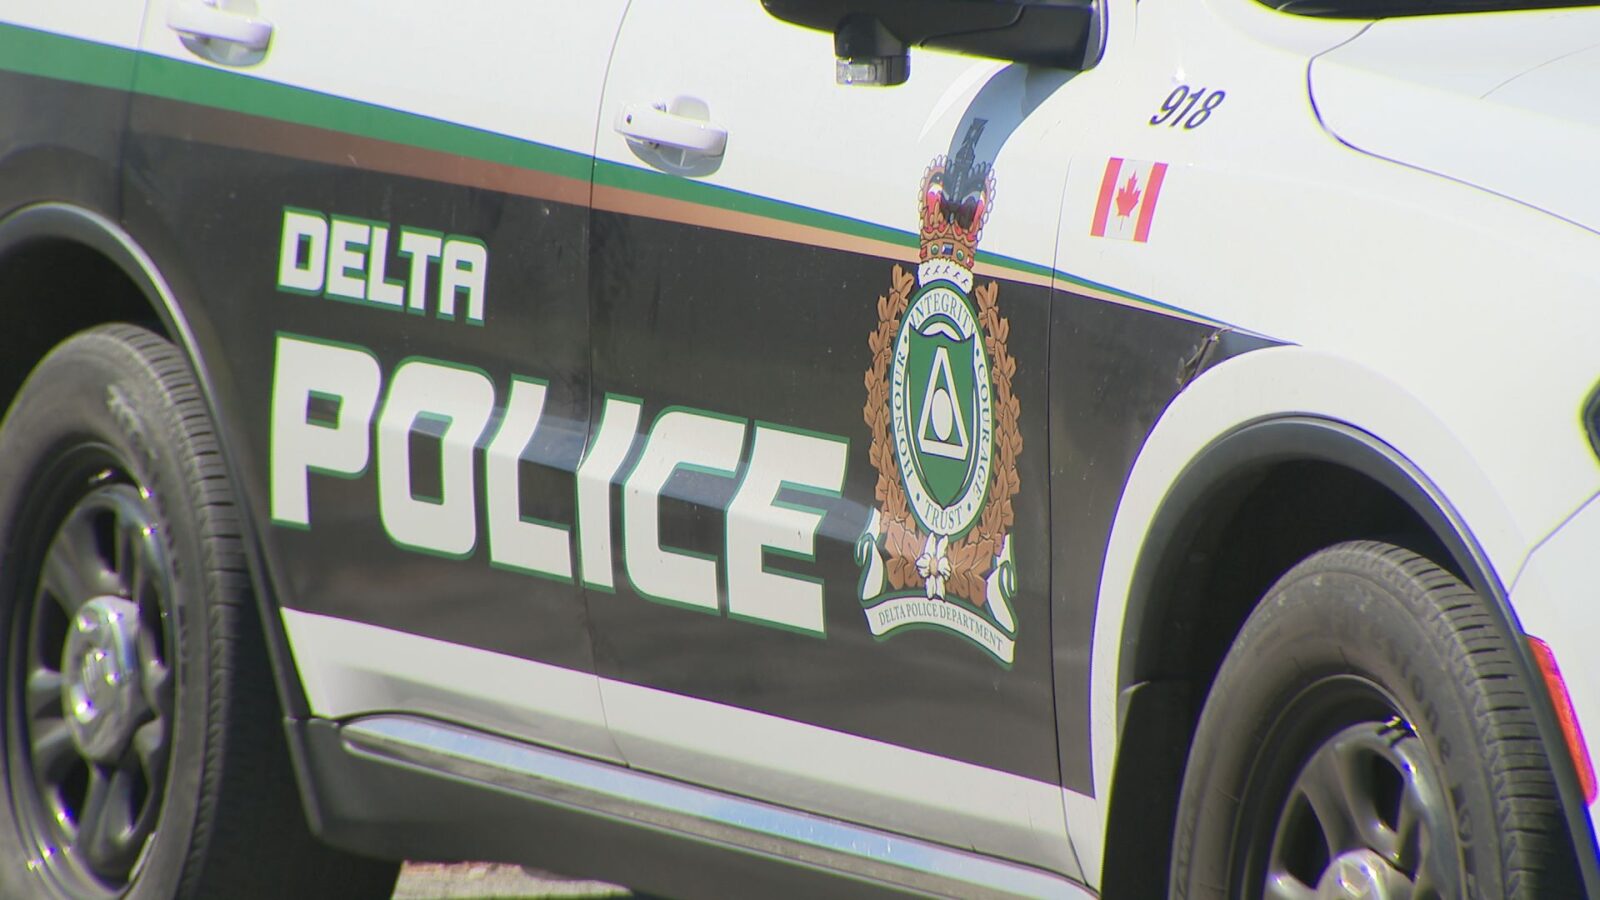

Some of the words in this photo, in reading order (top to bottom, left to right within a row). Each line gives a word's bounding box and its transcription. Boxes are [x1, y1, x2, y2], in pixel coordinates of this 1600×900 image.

[1150, 85, 1226, 129] 918
[277, 206, 488, 327] DELTA
[909, 292, 976, 334] INTEGRITY
[894, 351, 914, 479] HONOUR
[973, 363, 990, 501] COURAGE
[270, 331, 851, 639] POLICE
[924, 499, 964, 530] TRUST
[878, 607, 907, 627] DELTA
[906, 603, 939, 619] POLICE
[939, 604, 1004, 651] DEPARTMENT
